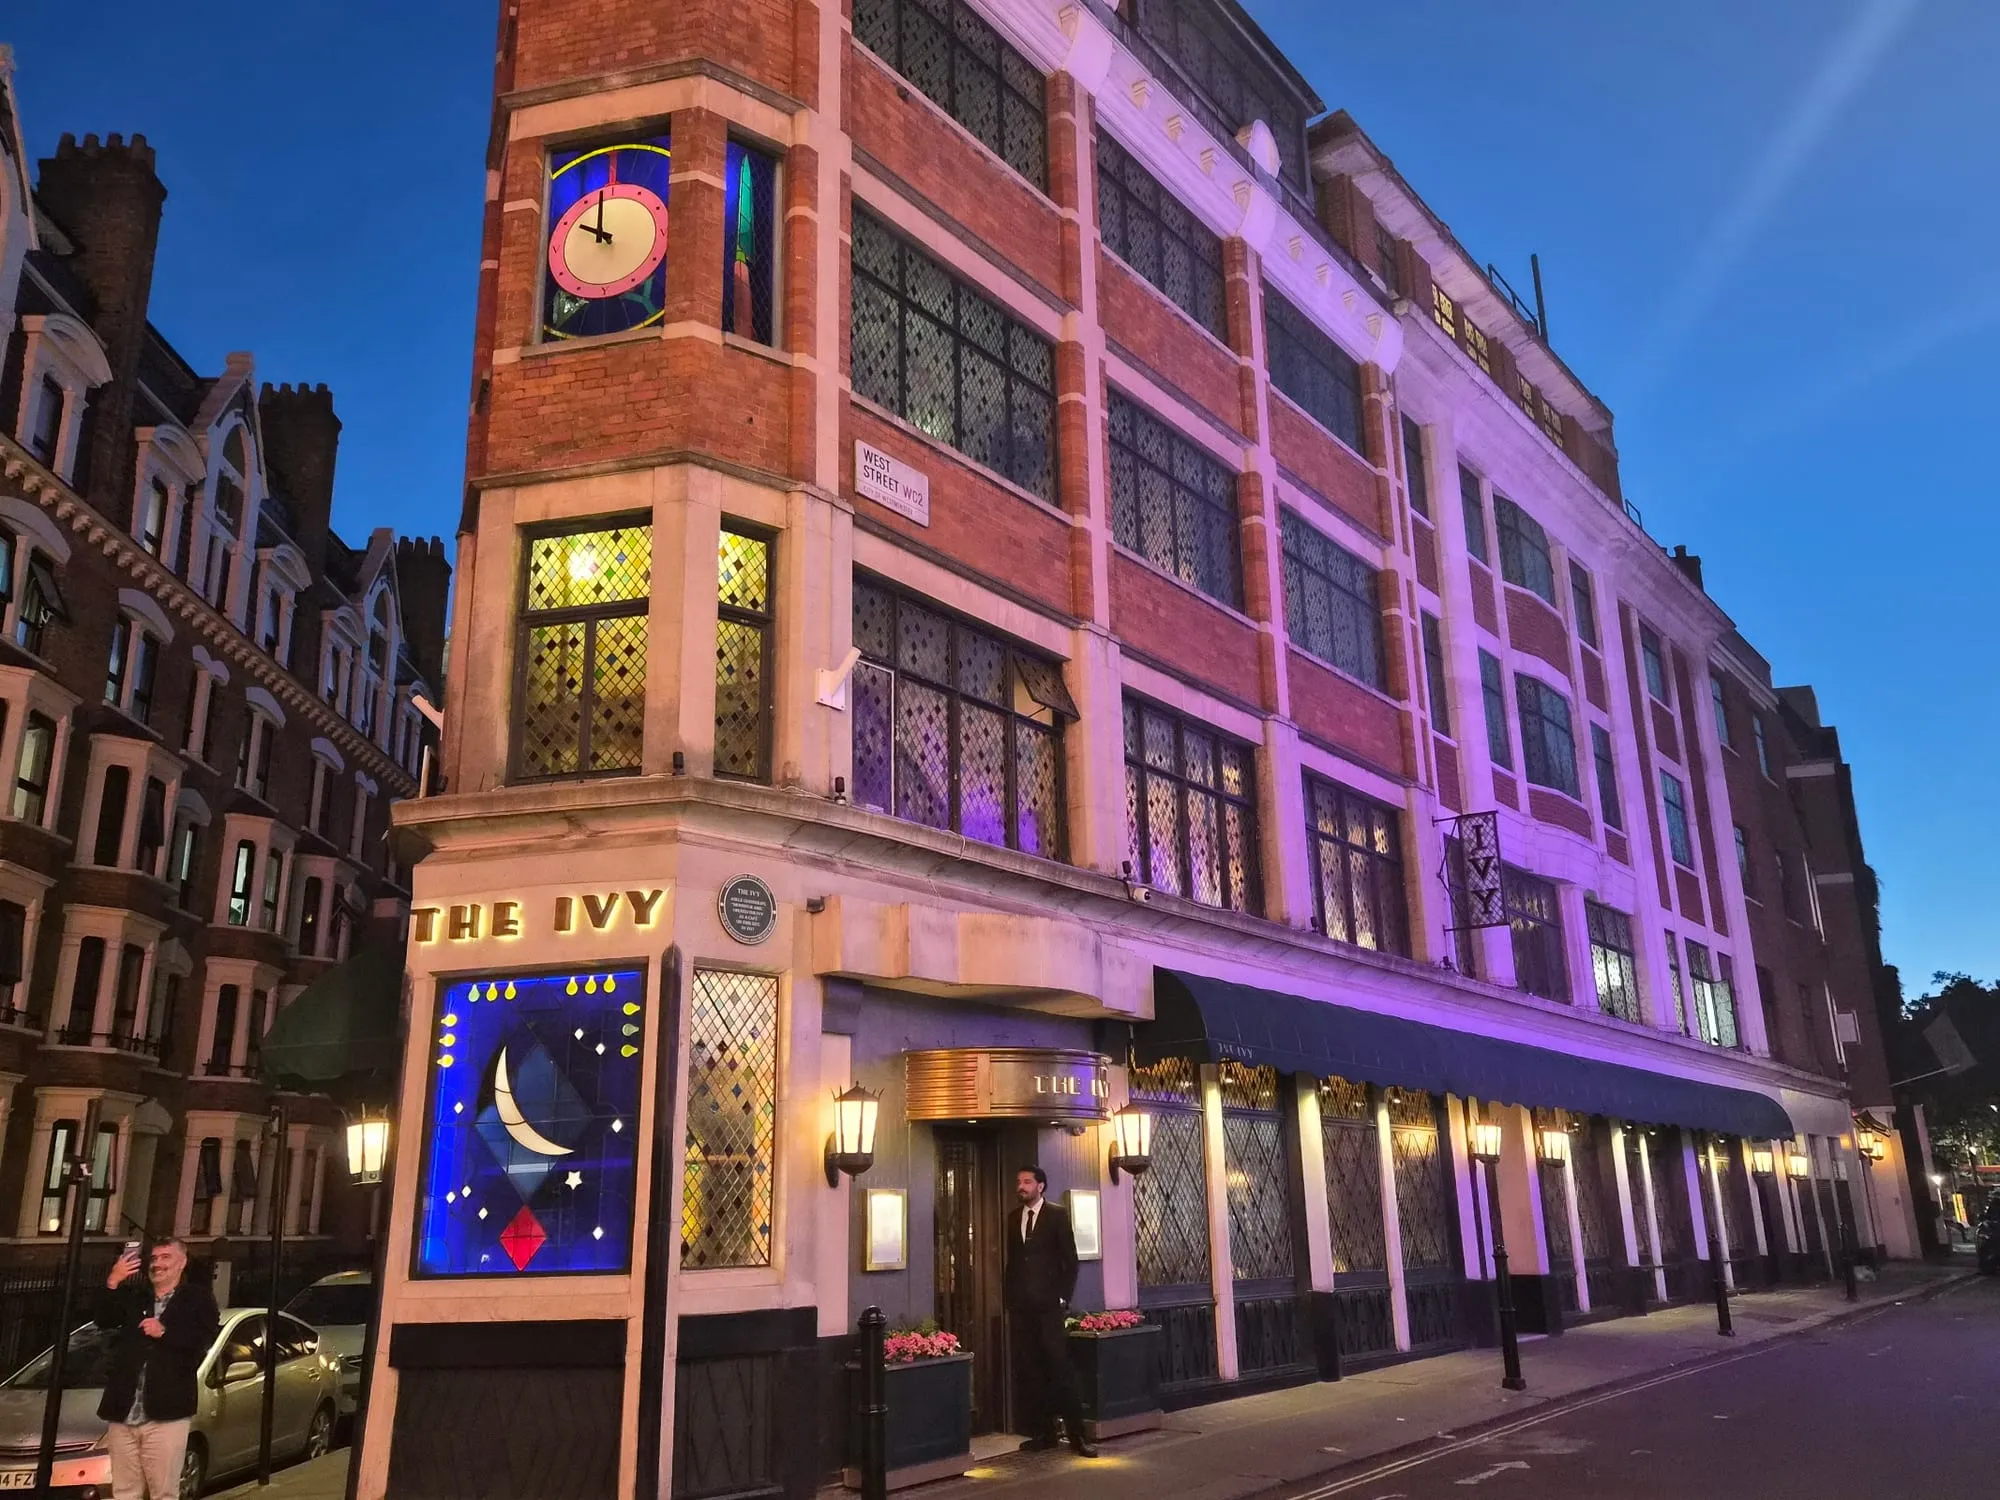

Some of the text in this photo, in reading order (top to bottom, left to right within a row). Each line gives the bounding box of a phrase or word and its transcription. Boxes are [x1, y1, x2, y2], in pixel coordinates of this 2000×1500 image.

[863, 448, 890, 473] WEST
[863, 465, 923, 507] STREET WC2
[1468, 824, 1499, 914] IVY
[411, 890, 664, 943] THE IVY
[1034, 1075, 1080, 1095] THE
